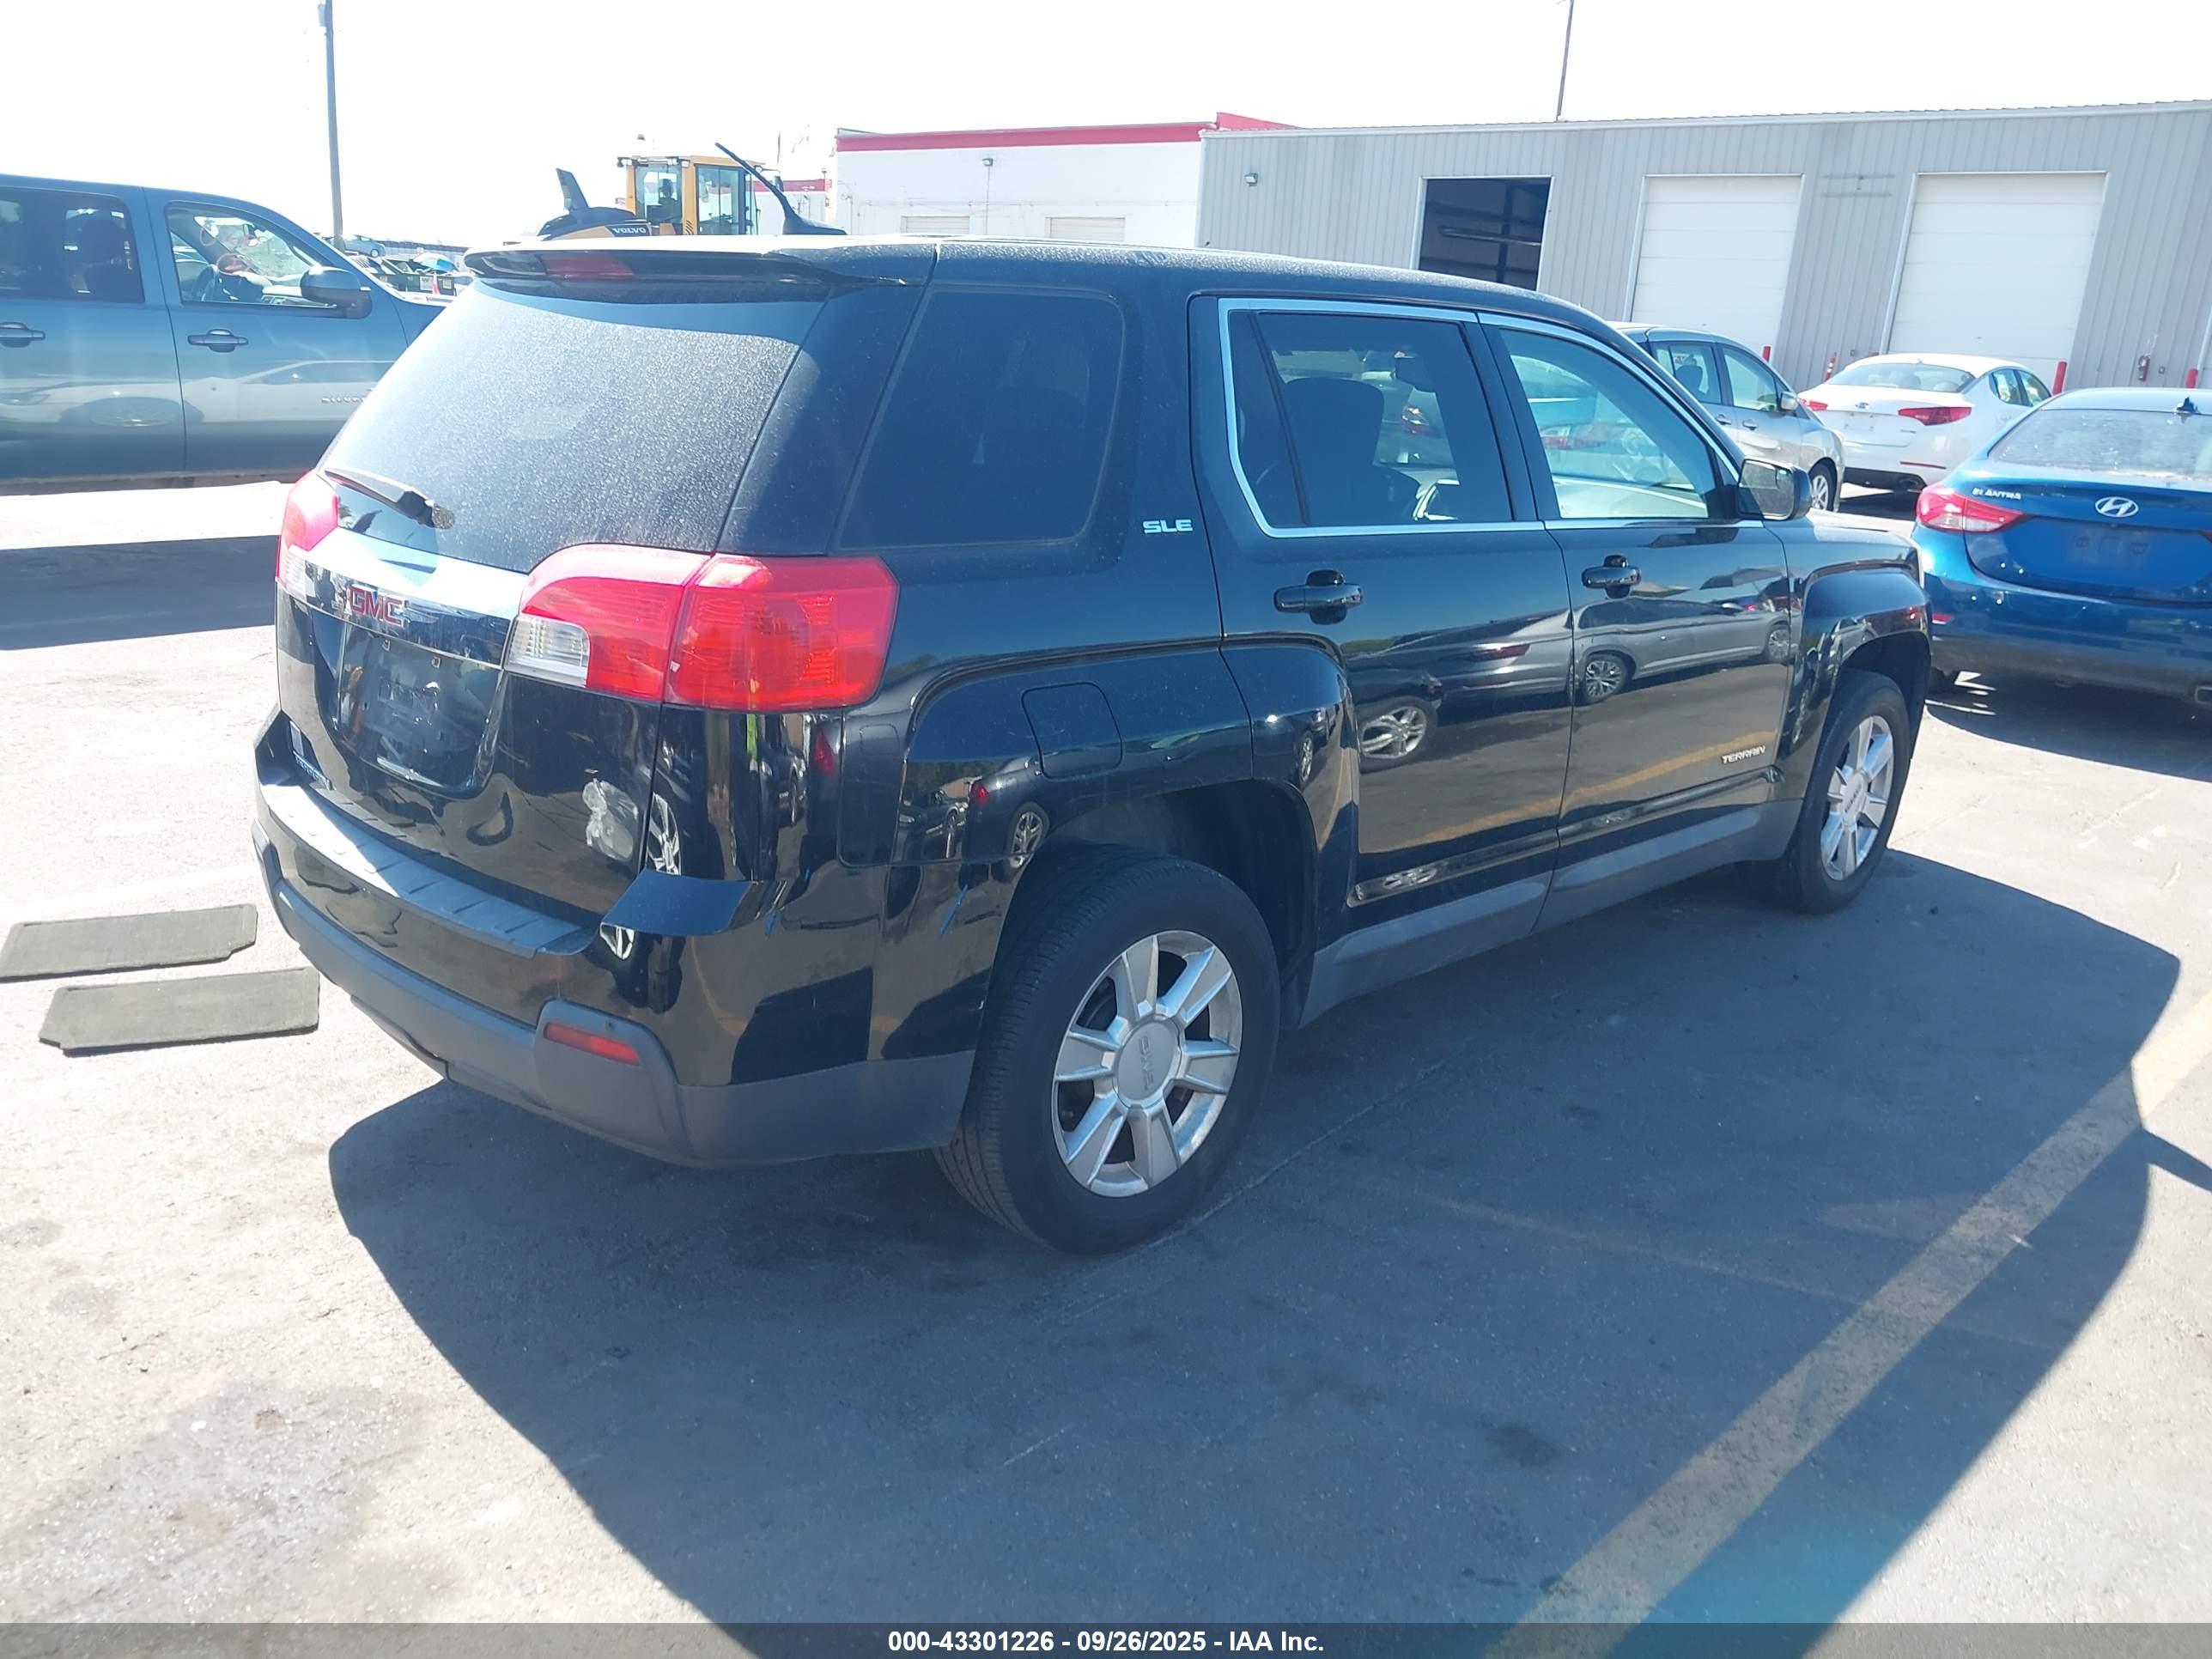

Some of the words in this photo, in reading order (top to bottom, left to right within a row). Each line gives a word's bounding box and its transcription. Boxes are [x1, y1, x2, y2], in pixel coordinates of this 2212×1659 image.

[1972, 487, 2021, 500] ELANTRA
[1142, 519, 1194, 533] SLE
[346, 586, 405, 628] GMC
[1721, 744, 1765, 764] TERRAIN
